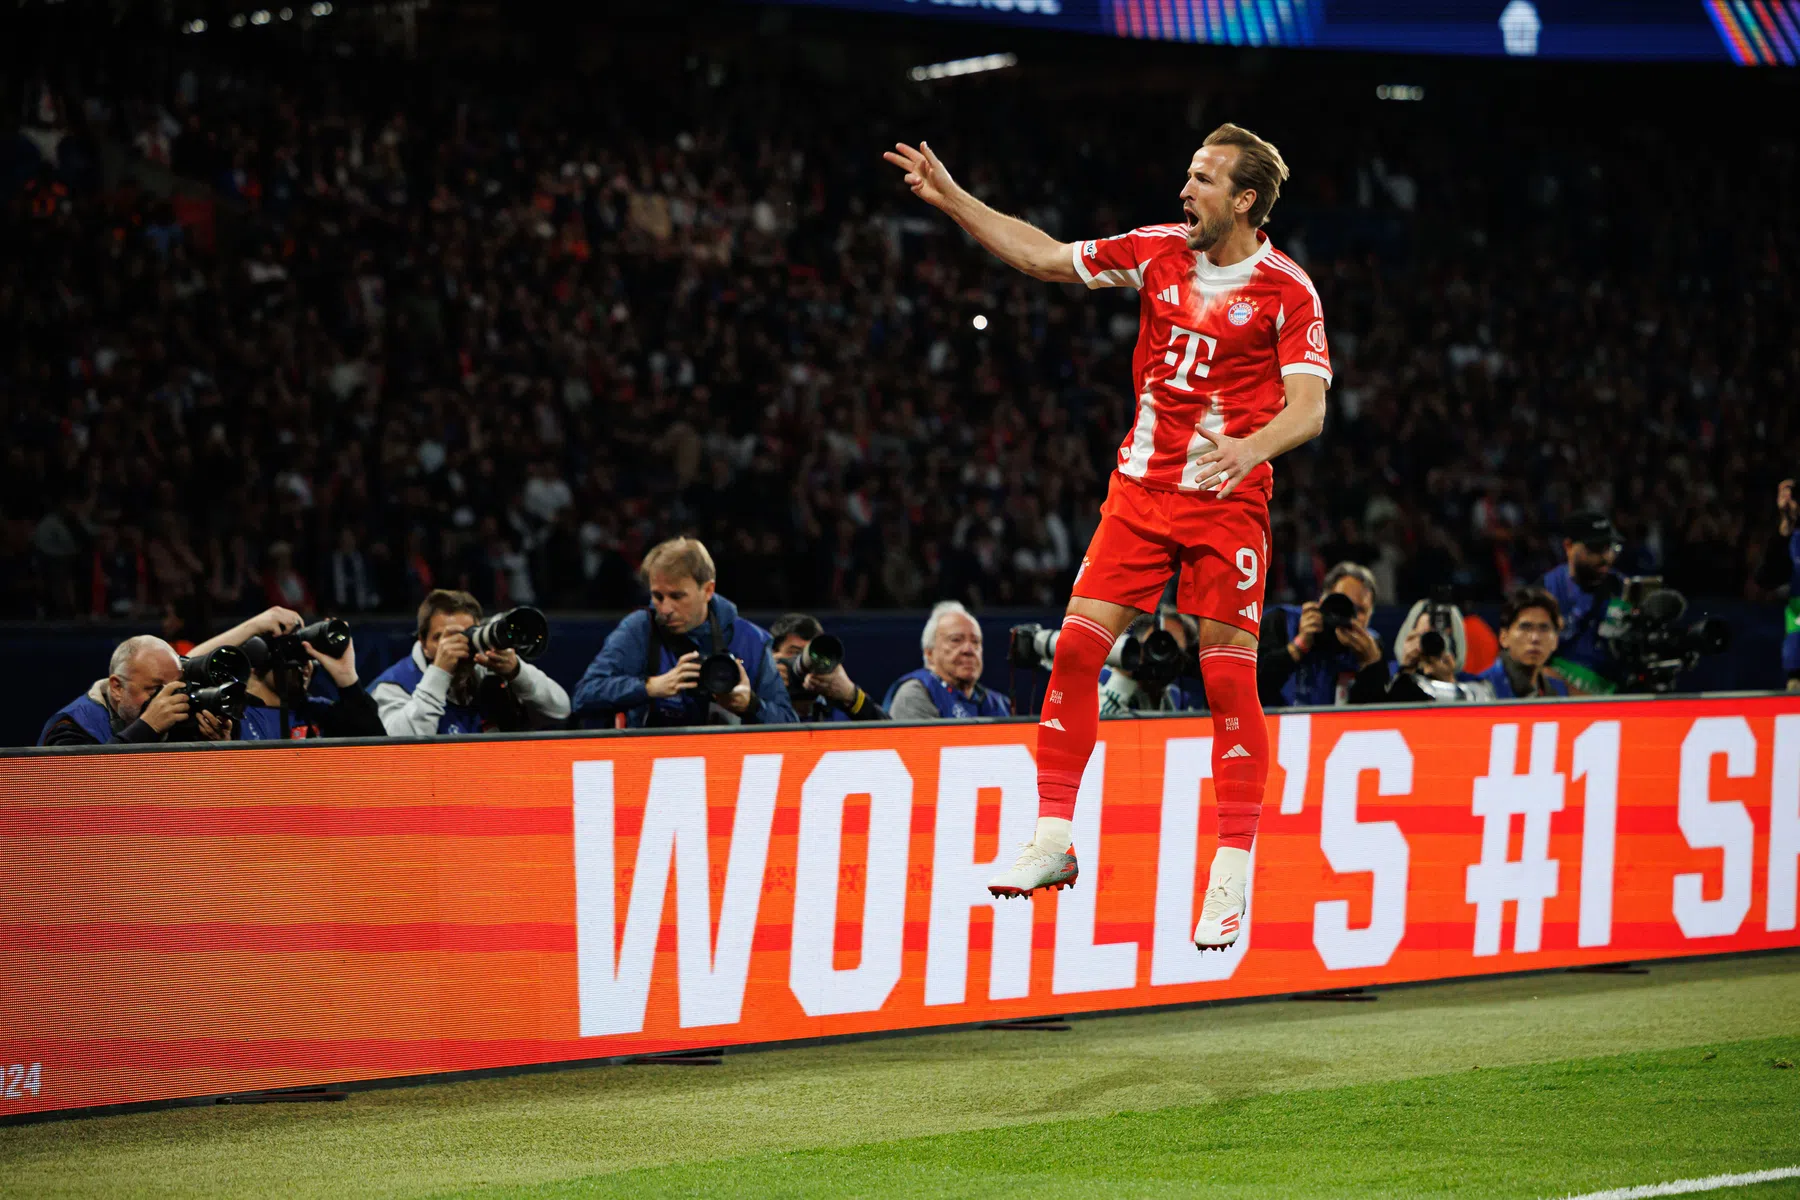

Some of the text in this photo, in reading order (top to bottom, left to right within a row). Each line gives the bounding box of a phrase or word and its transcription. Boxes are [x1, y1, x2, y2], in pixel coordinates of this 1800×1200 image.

[1164, 325, 1217, 392] T
[1236, 547, 1257, 590] 9
[572, 714, 1414, 1037] WORLD'S
[1465, 720, 1621, 957] #1
